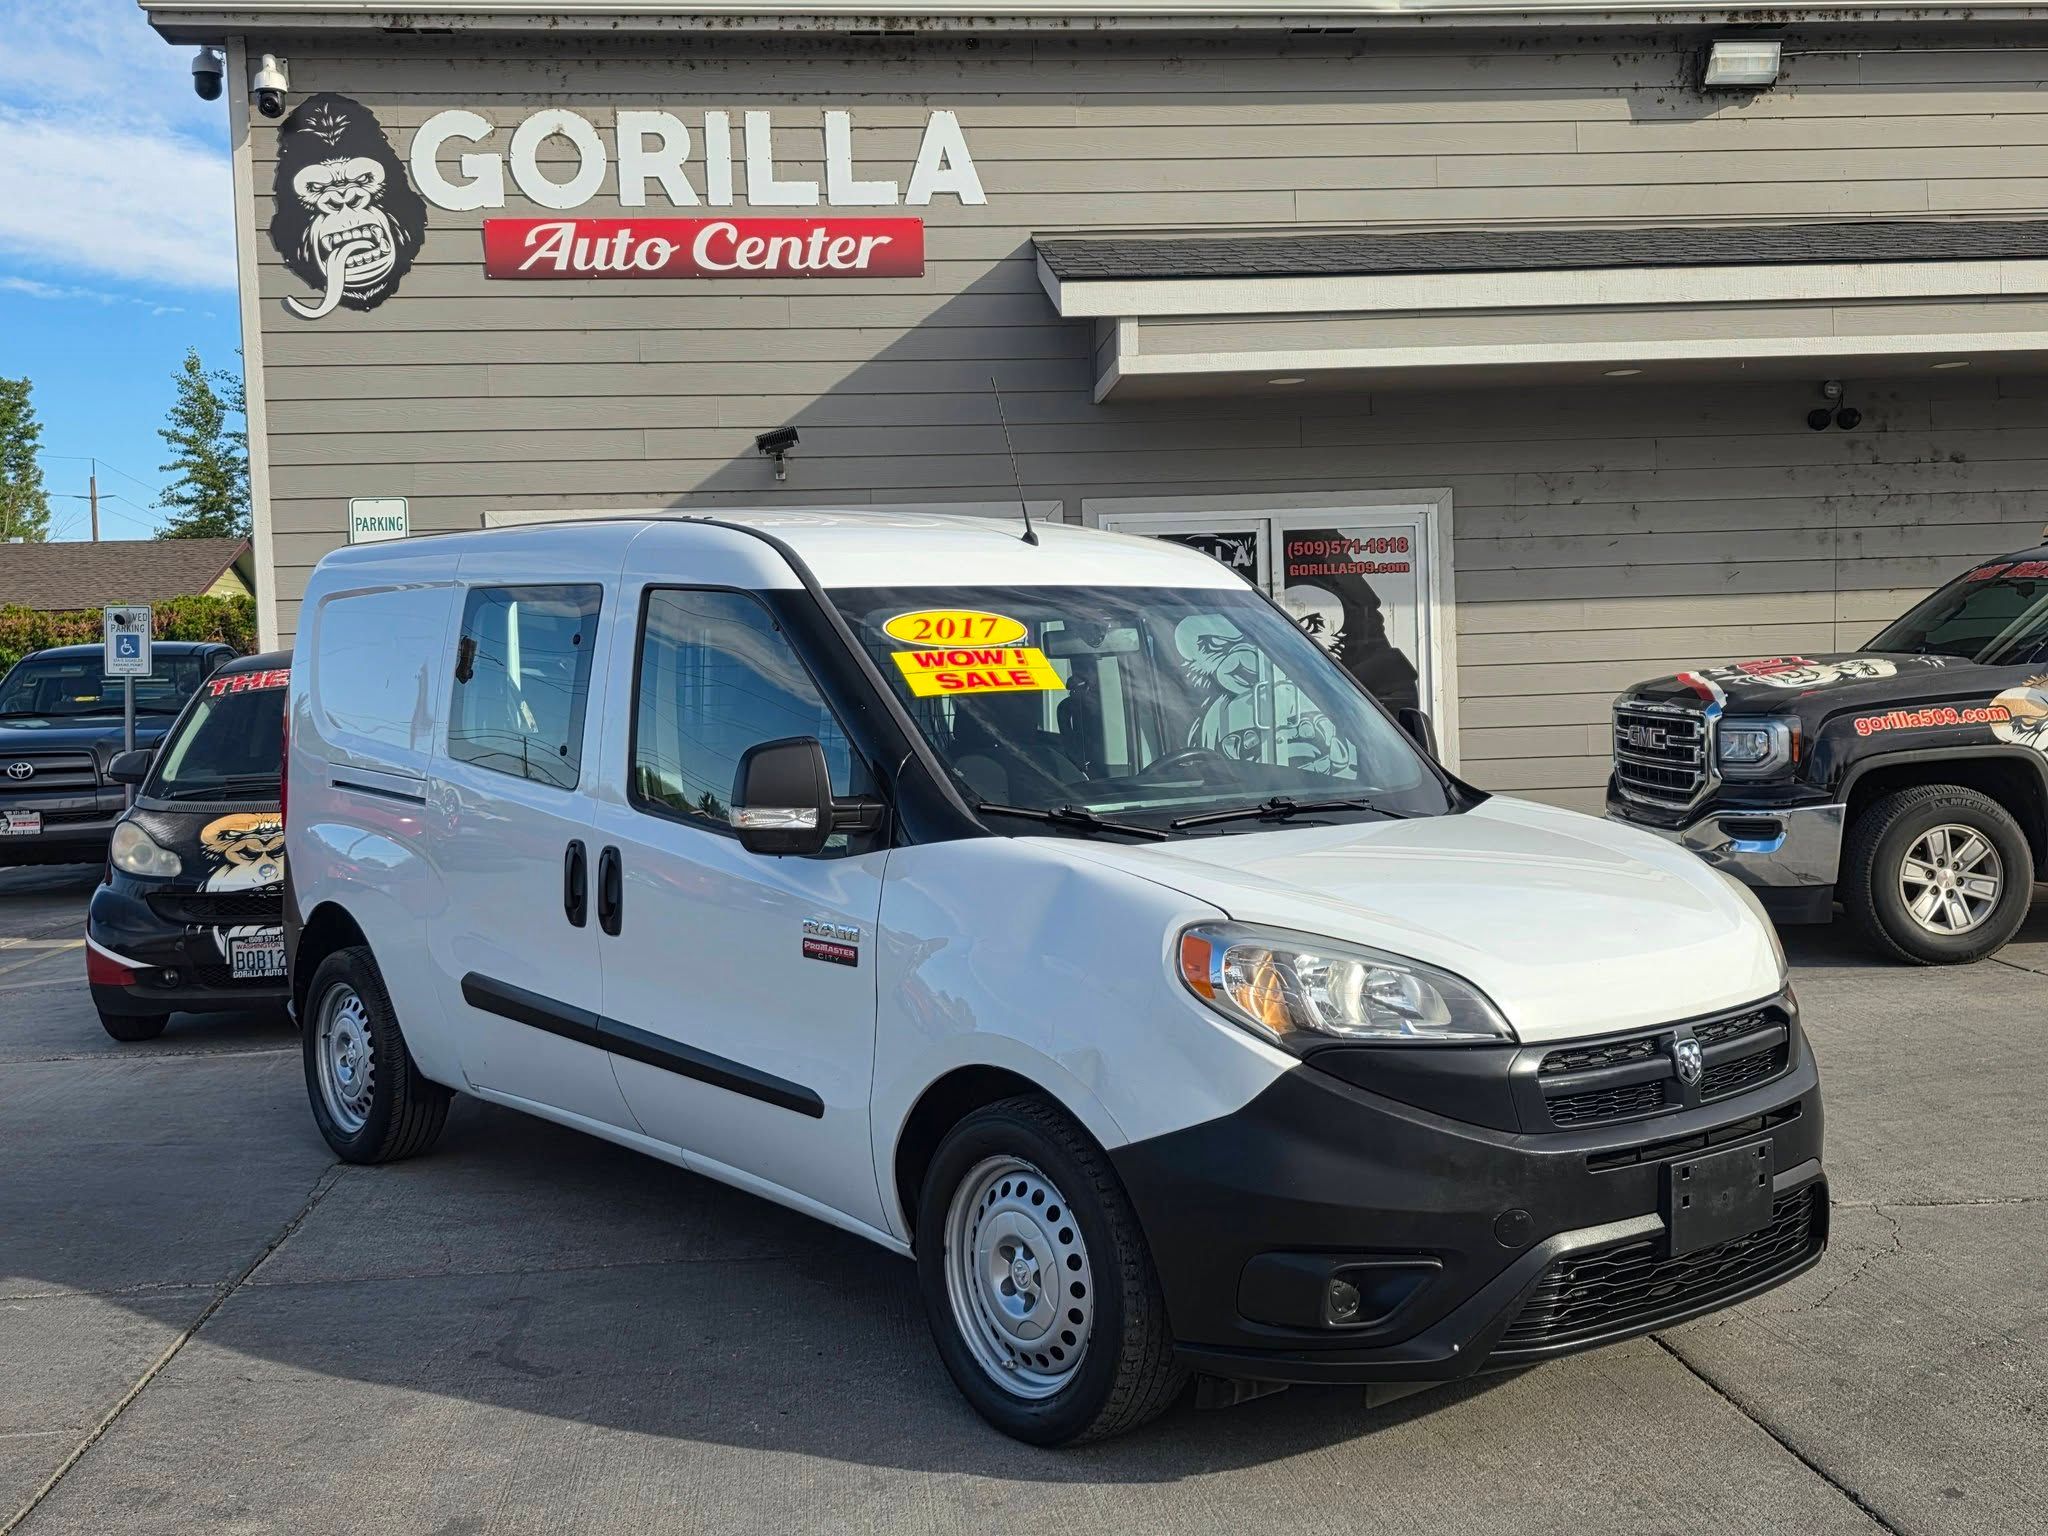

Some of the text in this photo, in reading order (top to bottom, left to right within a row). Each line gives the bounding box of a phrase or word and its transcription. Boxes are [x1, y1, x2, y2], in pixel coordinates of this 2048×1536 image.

[410, 108, 988, 211] GORILLA
[517, 221, 893, 272] Auto Center
[355, 516, 403, 532] PARKING
[1287, 537, 1409, 558] (509)571-1818
[1289, 561, 1410, 577] GORILLA509.com
[110, 624, 145, 633] PARKING
[913, 617, 998, 640] 2017
[913, 650, 1005, 669] WOW
[207, 669, 292, 697] THE
[935, 670, 1036, 690] SALE
[1854, 706, 2012, 737] gorilla509.com
[1629, 724, 1666, 750] GMC
[803, 918, 860, 942] RAM
[236, 942, 281, 950] WASHINGTON
[817, 952, 840, 962] CITY
[264, 969, 283, 977] AUTO
